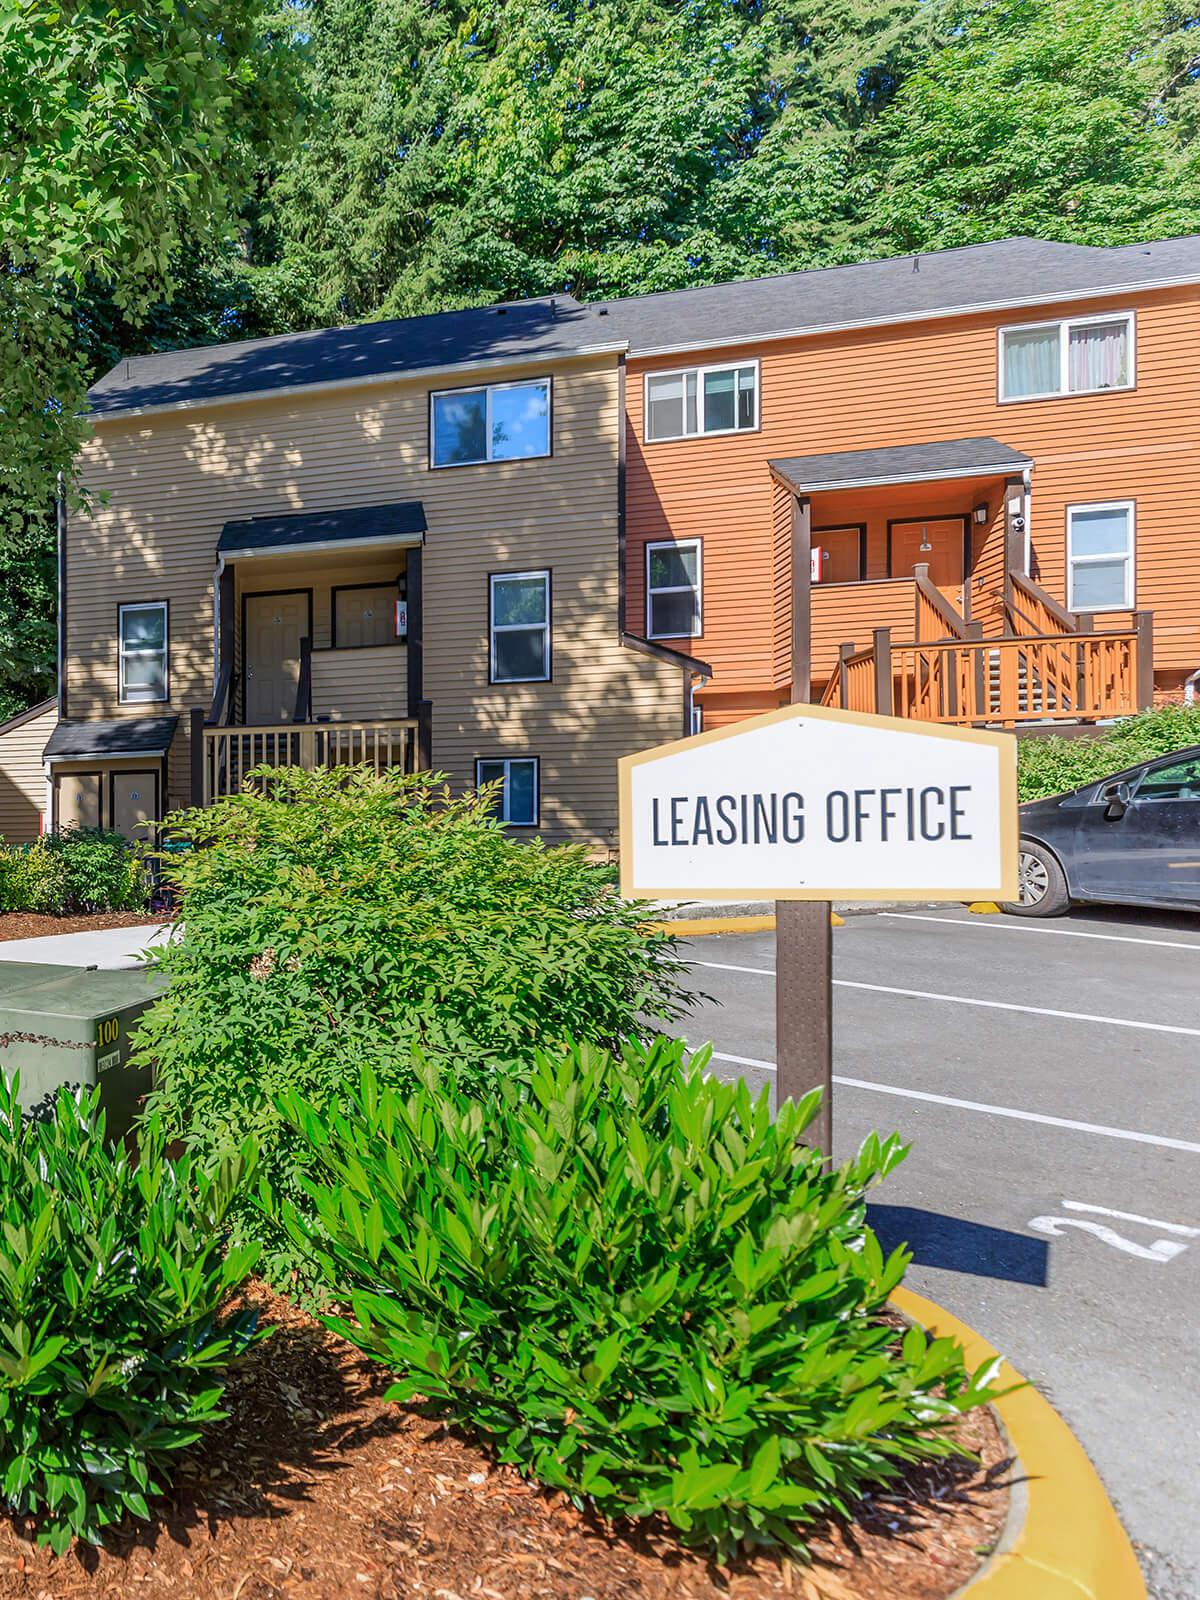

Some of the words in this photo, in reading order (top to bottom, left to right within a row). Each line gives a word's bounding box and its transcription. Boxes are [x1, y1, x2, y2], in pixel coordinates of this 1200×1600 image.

[652, 792, 805, 846] LEASING
[826, 785, 972, 843] OFFICE
[98, 1017, 119, 1048] 100
